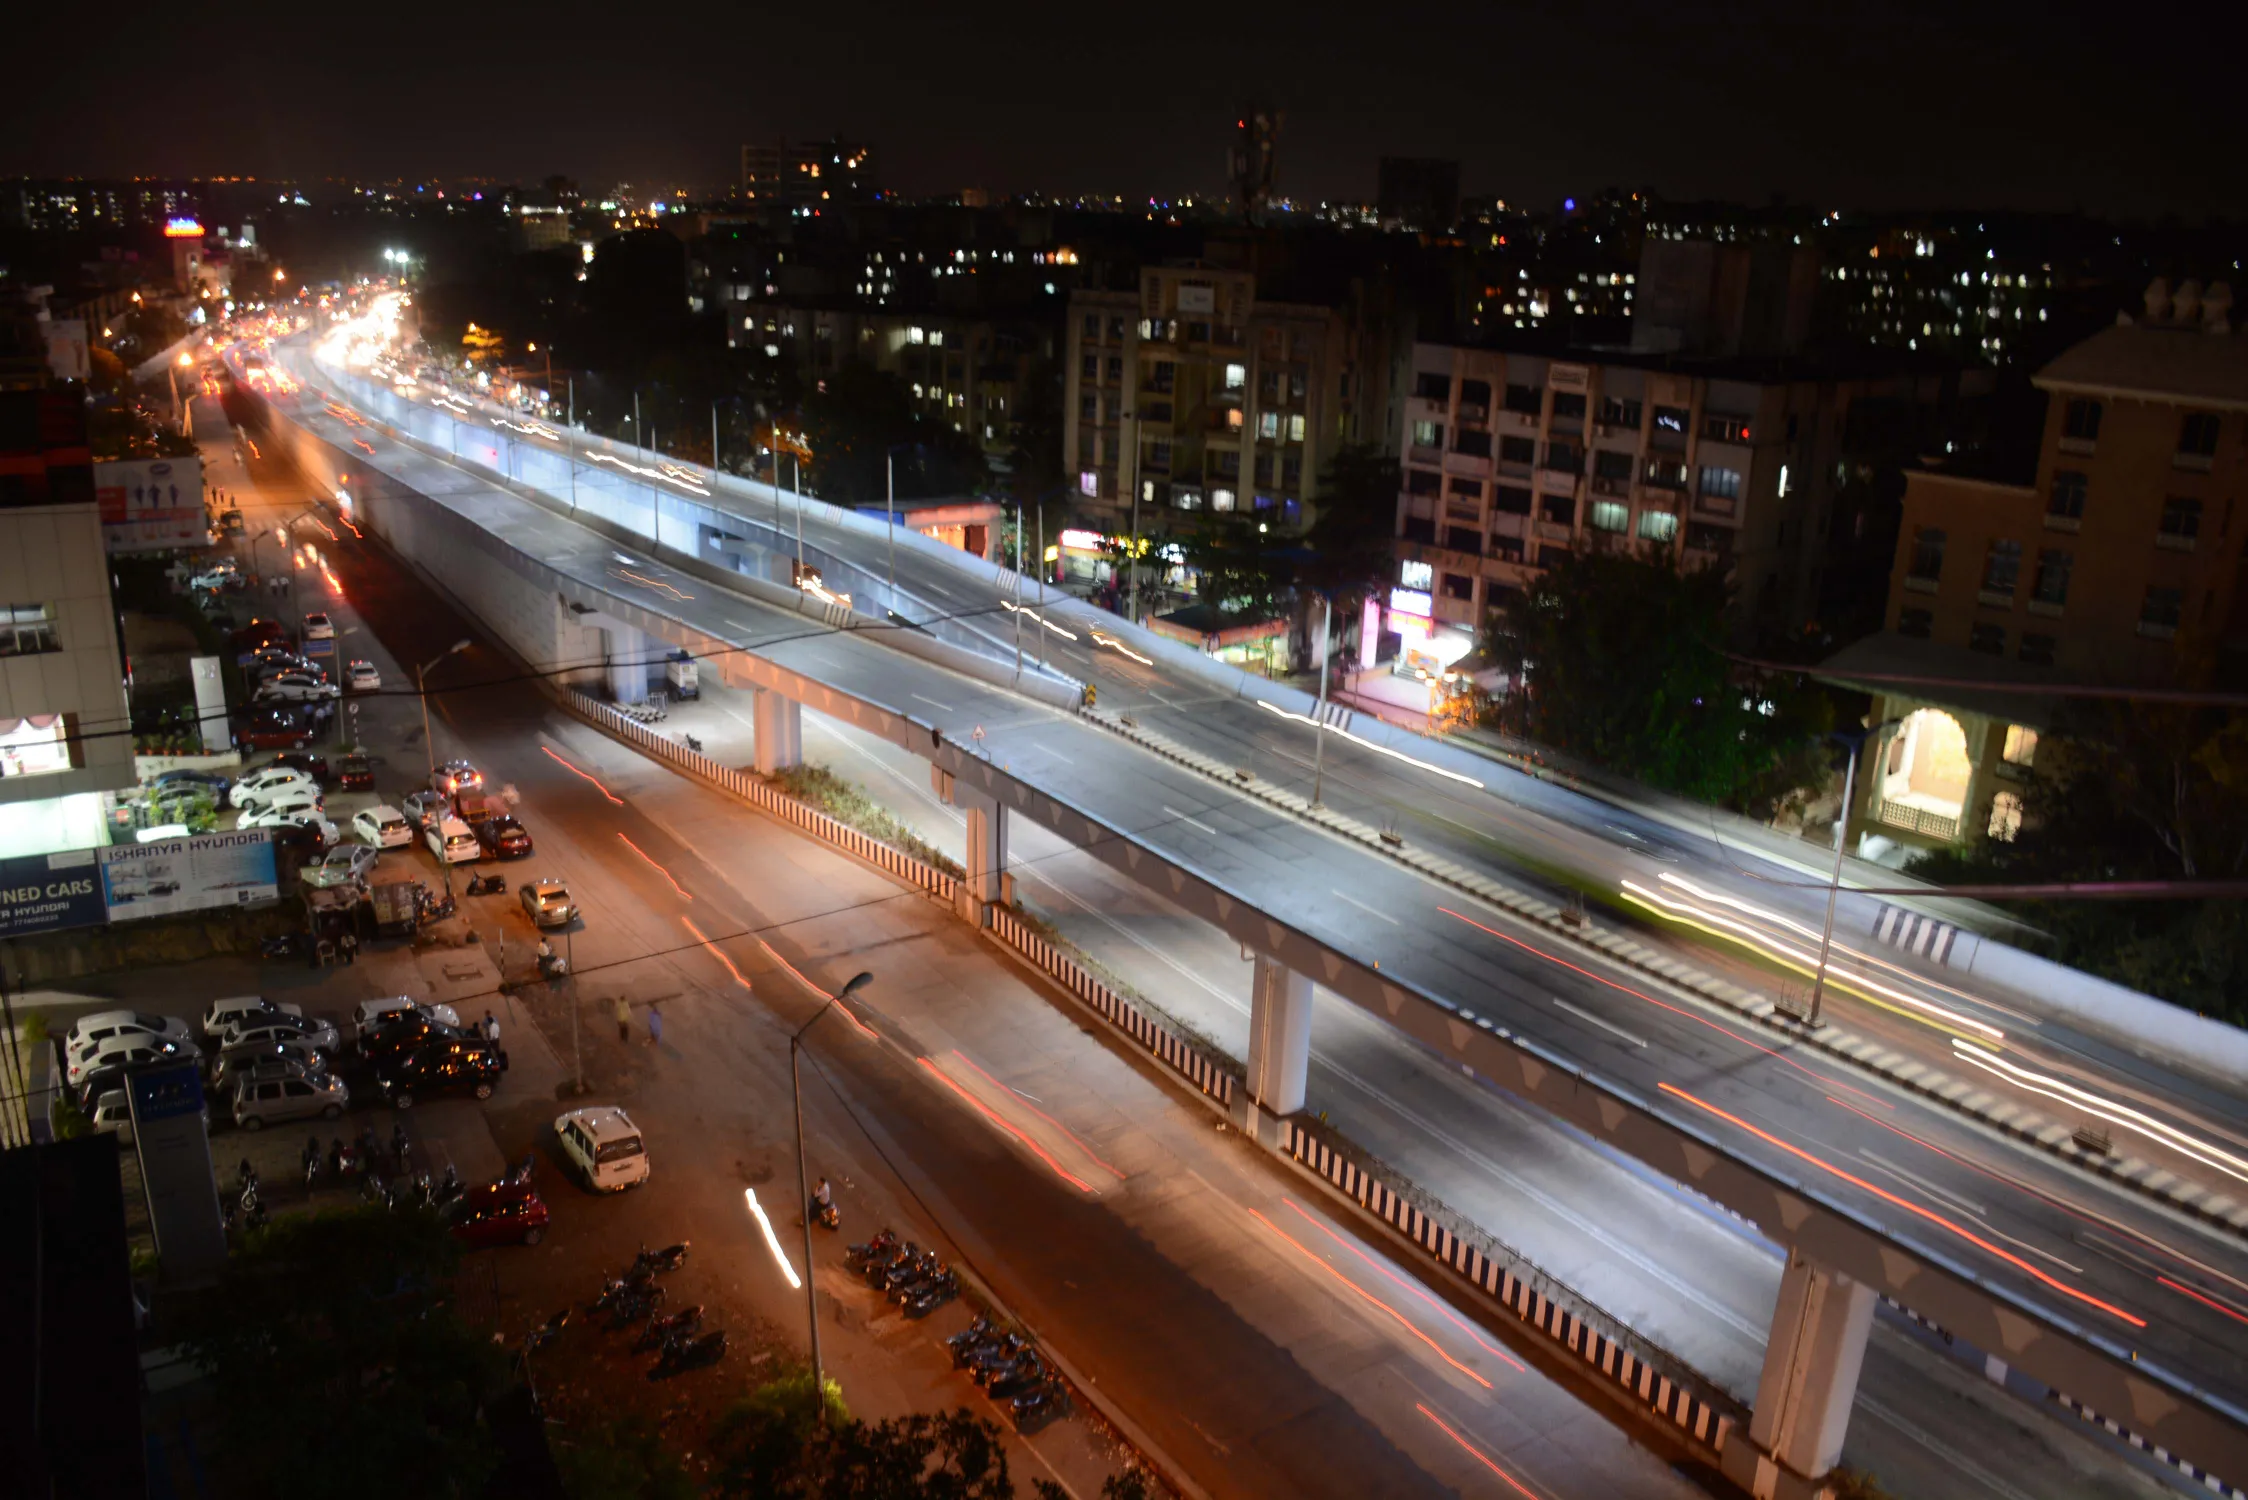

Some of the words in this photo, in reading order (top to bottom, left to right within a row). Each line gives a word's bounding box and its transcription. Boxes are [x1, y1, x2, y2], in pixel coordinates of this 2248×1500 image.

[109, 843, 182, 861] ISHANYA
[190, 832, 264, 851] HYUNDAI
[0, 886, 41, 904] NED
[46, 878, 93, 898] CARS
[15, 901, 70, 916] HYUNDAI
